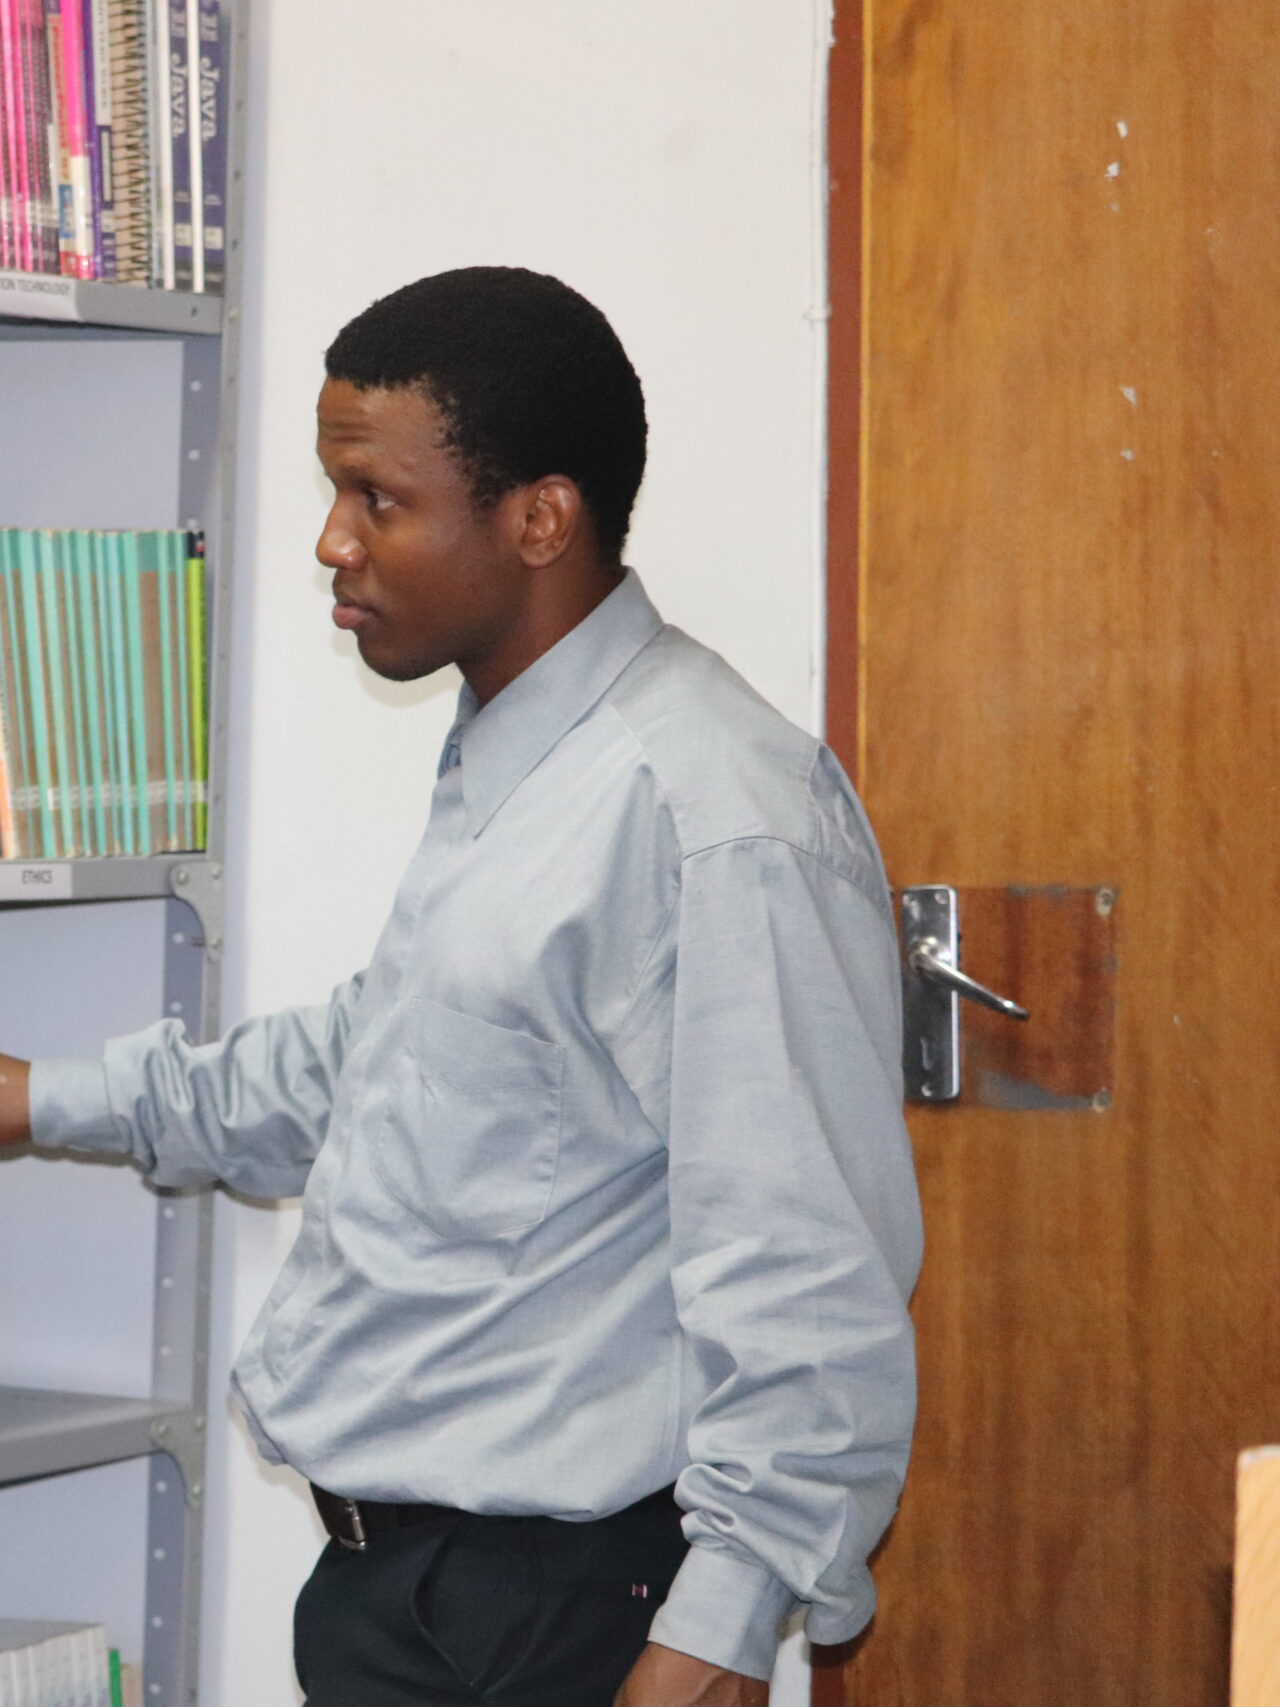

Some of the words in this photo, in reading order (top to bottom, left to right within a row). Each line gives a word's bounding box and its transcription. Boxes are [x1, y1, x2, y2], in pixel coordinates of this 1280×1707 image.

[200, 56, 219, 142] Java
[17, 279, 70, 296] TECHNOLOGY
[22, 869, 52, 884] ETHICS
